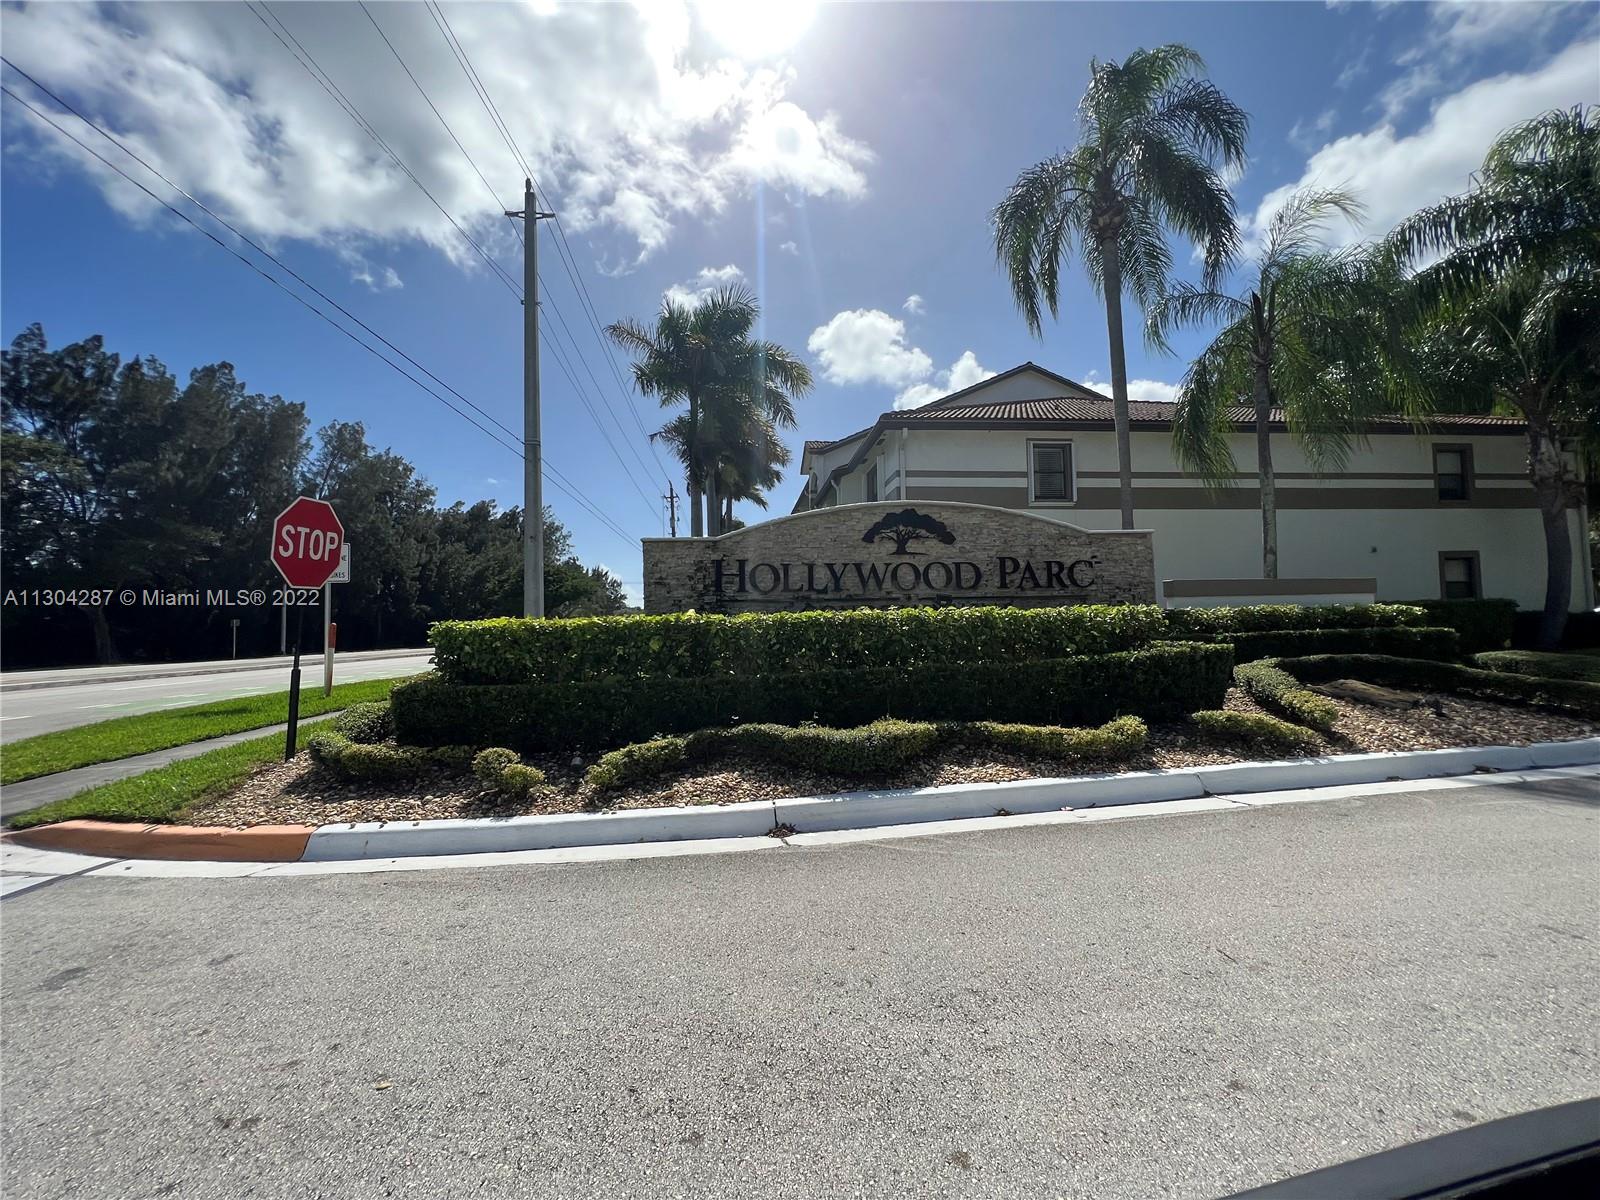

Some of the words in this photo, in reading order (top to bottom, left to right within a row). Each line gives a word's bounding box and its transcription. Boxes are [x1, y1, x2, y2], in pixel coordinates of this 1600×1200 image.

[278, 524, 338, 561] STOP
[711, 559, 983, 595] HOLLYWOOD
[996, 556, 1096, 590] PARC
